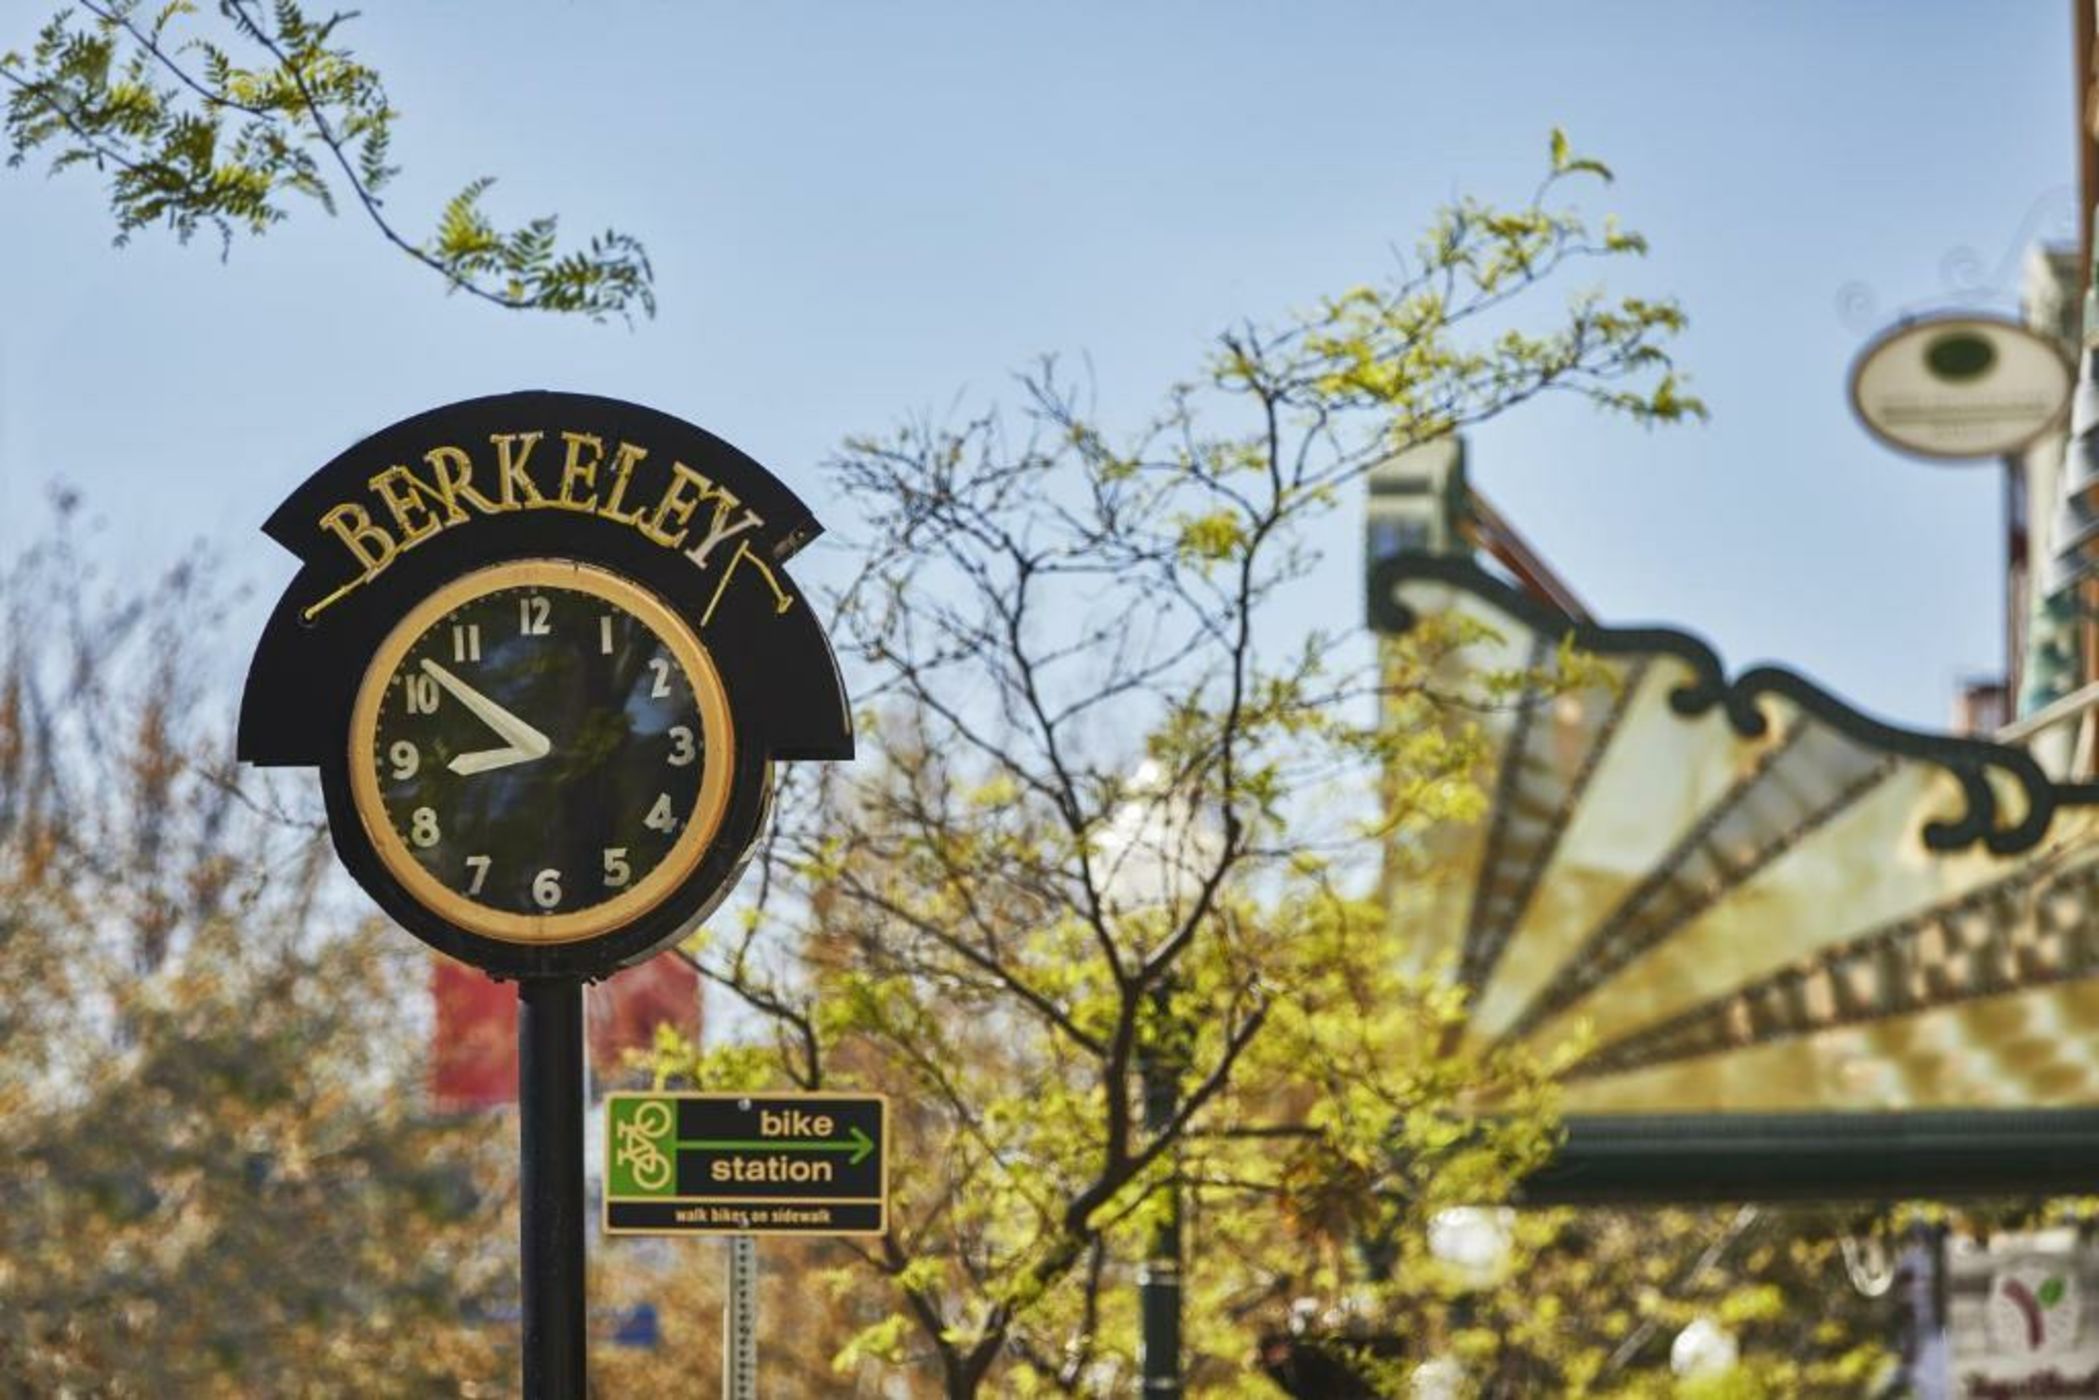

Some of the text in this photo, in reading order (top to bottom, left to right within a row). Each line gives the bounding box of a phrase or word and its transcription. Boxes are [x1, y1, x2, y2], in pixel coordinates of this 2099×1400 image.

[319, 431, 765, 583] BERKELEY
[519, 596, 551, 636] 12
[601, 616, 613, 654] 1
[453, 624, 480, 662] 11
[405, 672, 440, 714] 10
[649, 657, 671, 698] 2
[389, 740, 419, 780] 9
[668, 726, 695, 766] 3
[411, 806, 440, 847] 8
[644, 792, 678, 833] 4
[465, 855, 492, 894] 7
[603, 848, 631, 886] 5
[532, 868, 562, 908] 6
[760, 1110, 834, 1137] bike
[711, 1156, 833, 1182] station
[675, 1208, 707, 1223] walk
[751, 1210, 769, 1223] on
[771, 1208, 831, 1223] sidewalk
